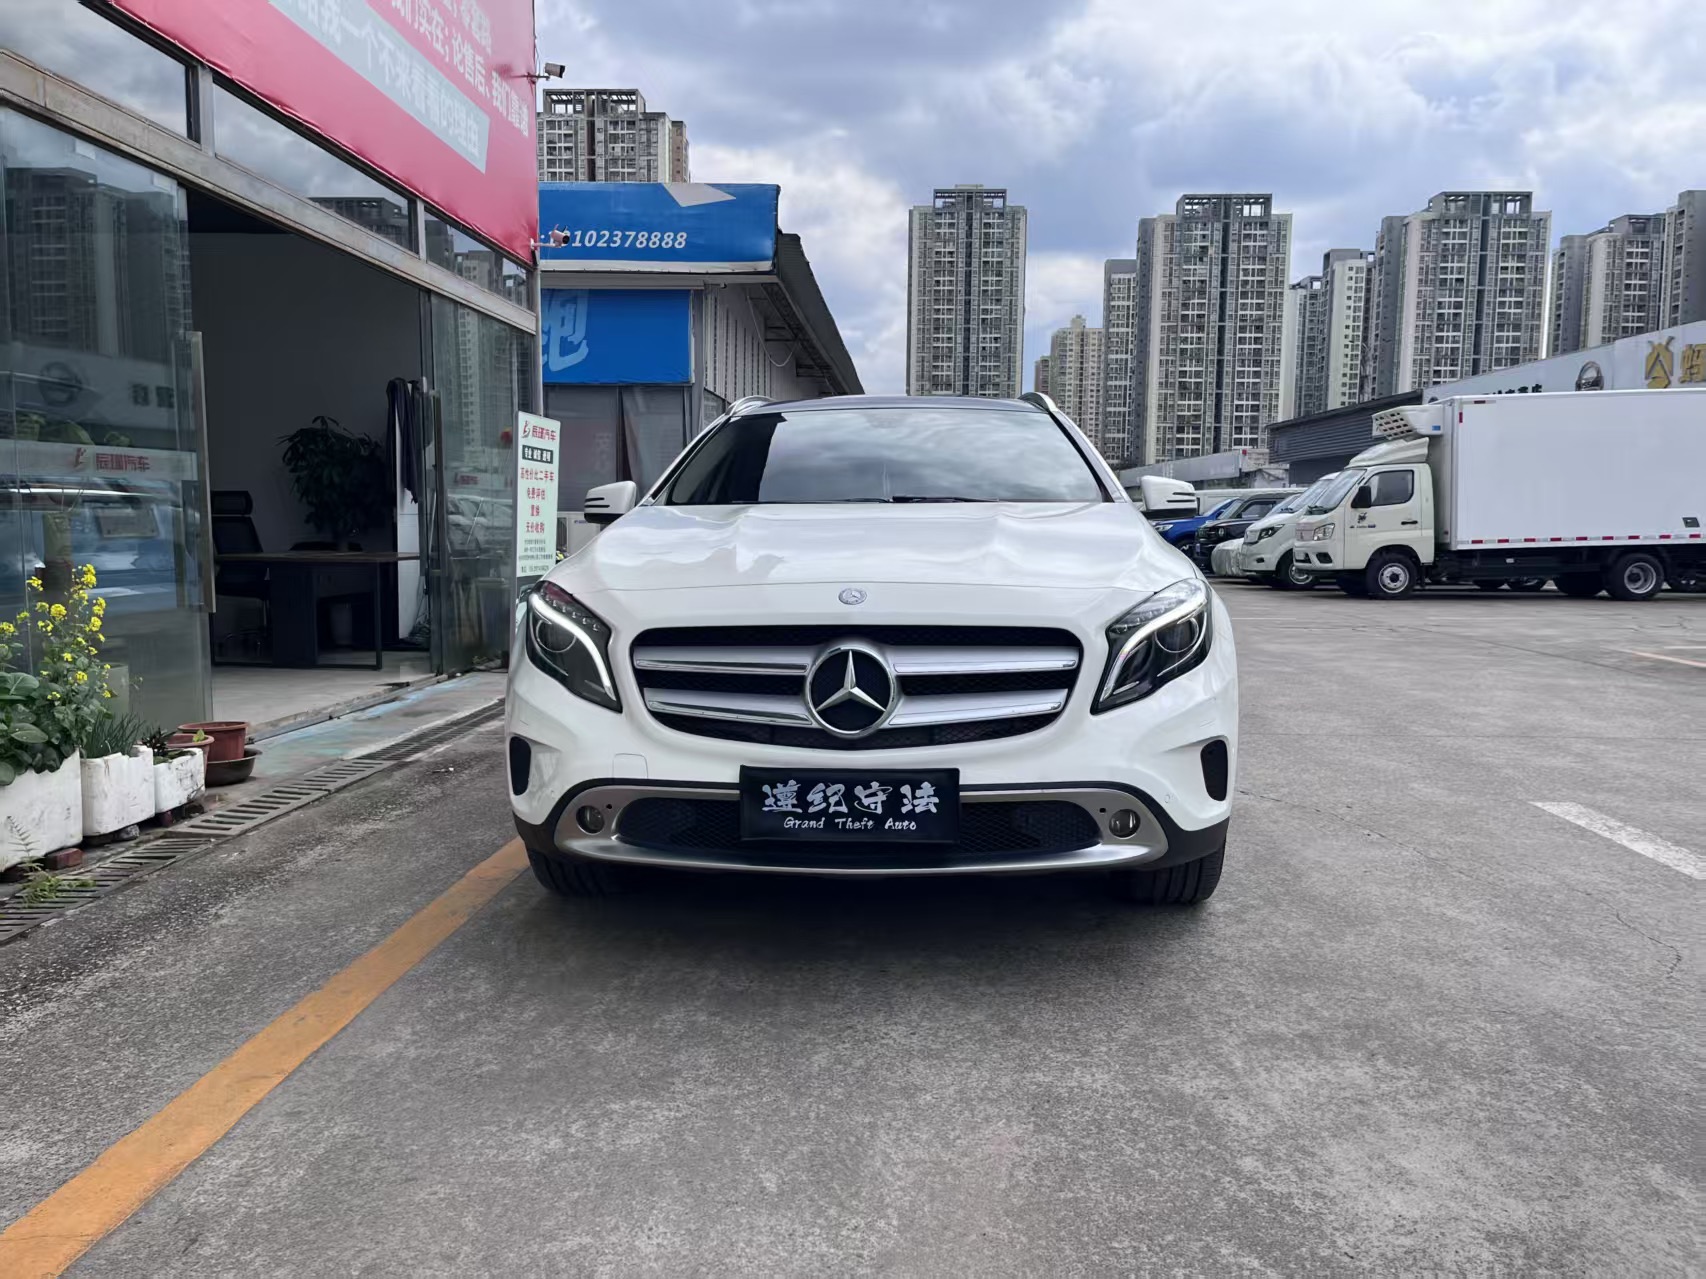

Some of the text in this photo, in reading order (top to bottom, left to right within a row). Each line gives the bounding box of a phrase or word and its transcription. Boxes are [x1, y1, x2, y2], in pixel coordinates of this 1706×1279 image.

[762, 779, 940, 814] 遵纪守法
[783, 817, 917, 830] Grand Theft Auto
